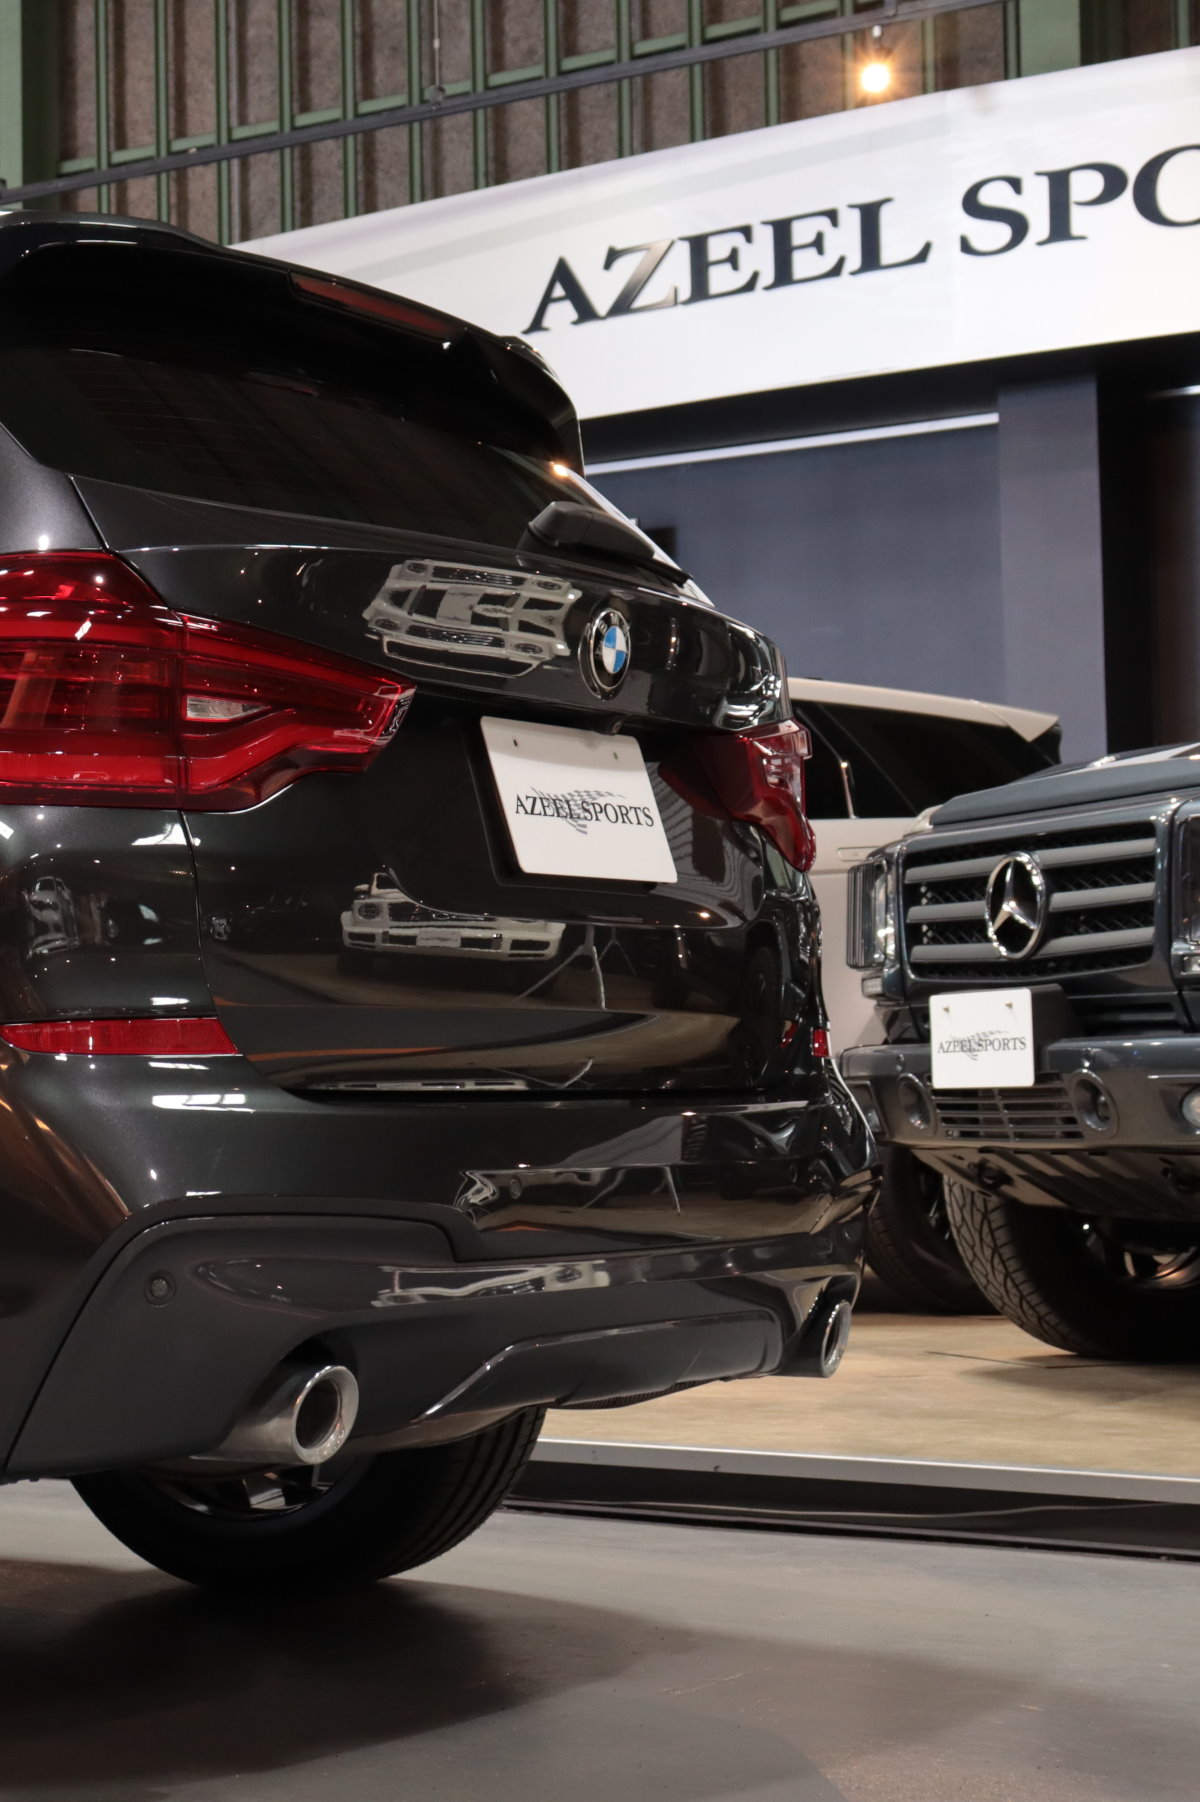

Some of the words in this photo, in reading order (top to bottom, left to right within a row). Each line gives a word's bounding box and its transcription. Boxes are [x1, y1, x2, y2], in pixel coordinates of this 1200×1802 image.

[521, 197, 932, 335] AZEEL
[515, 794, 580, 820] AZEEL
[581, 800, 655, 827] SPORTS
[937, 1040, 978, 1054] AZEEL
[977, 1036, 1027, 1052] SPORTS
